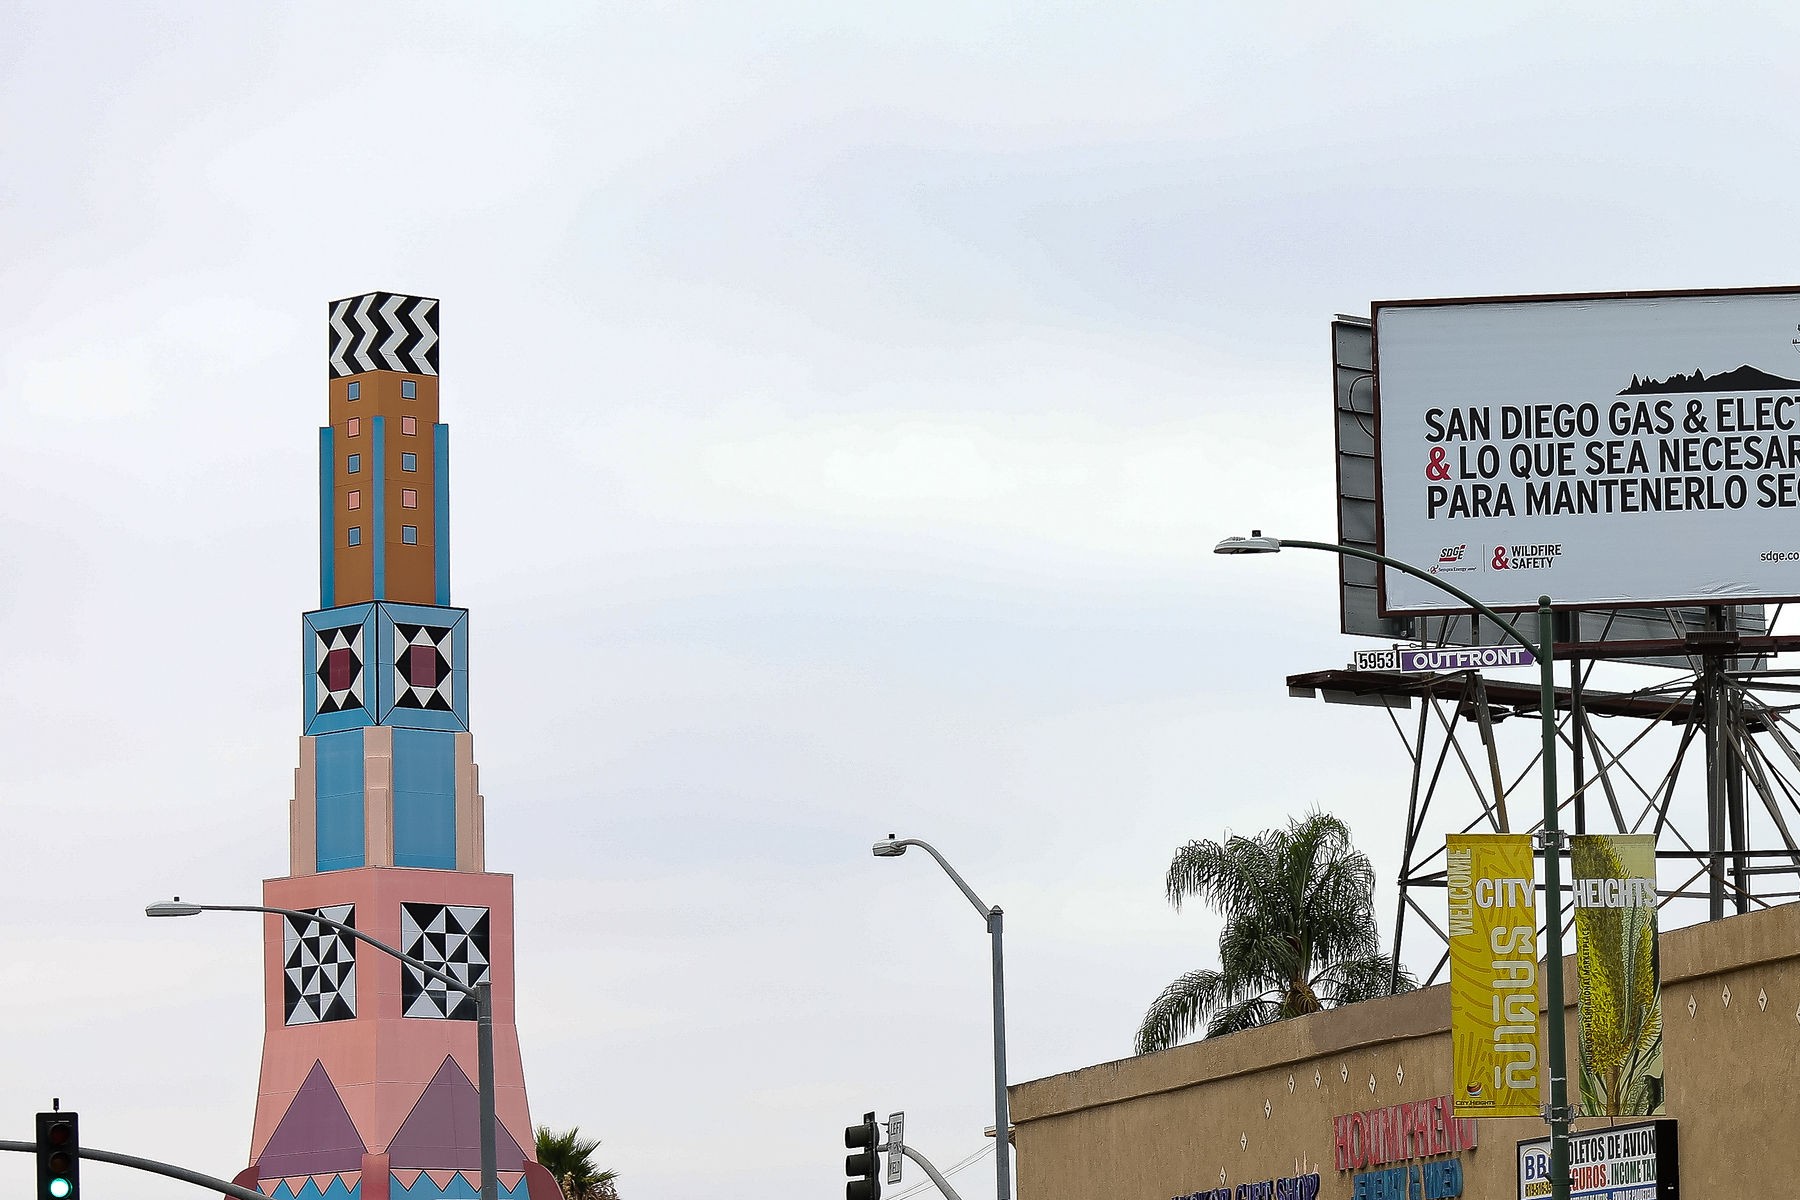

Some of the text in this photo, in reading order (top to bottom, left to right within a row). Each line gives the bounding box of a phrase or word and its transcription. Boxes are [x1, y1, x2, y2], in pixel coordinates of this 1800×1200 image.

[1425, 407, 1490, 442] SAN
[1501, 402, 1599, 439] DIEGO
[1608, 400, 1675, 436] GAS
[1683, 399, 1708, 433] &
[1425, 447, 1451, 481] &
[1459, 445, 1500, 479] LO
[1510, 442, 1576, 479] QUE
[1585, 440, 1649, 476] SEA
[1427, 483, 1516, 519] PARA
[1525, 474, 1747, 515] MANTENERLO
[1511, 544, 1562, 557] WILDFIRE
[1511, 557, 1554, 569] SAFETY
[1359, 648, 1525, 669] 5953 OUTFRONT
[1447, 847, 1473, 936] WELCOME
[1476, 878, 1535, 908] CITY
[1573, 878, 1656, 908] HEIGHTS
[1582, 926, 1592, 975] MARKETPLACE
[1583, 977, 1593, 1032] INTERNATIONAL
[1569, 1129, 1656, 1165] OLETOS DE AVION
[1423, 1157, 1463, 1200] VIDEO
[1525, 1154, 1552, 1180] BB
[1569, 1158, 1656, 1191] EGUROS INCOME TAX
